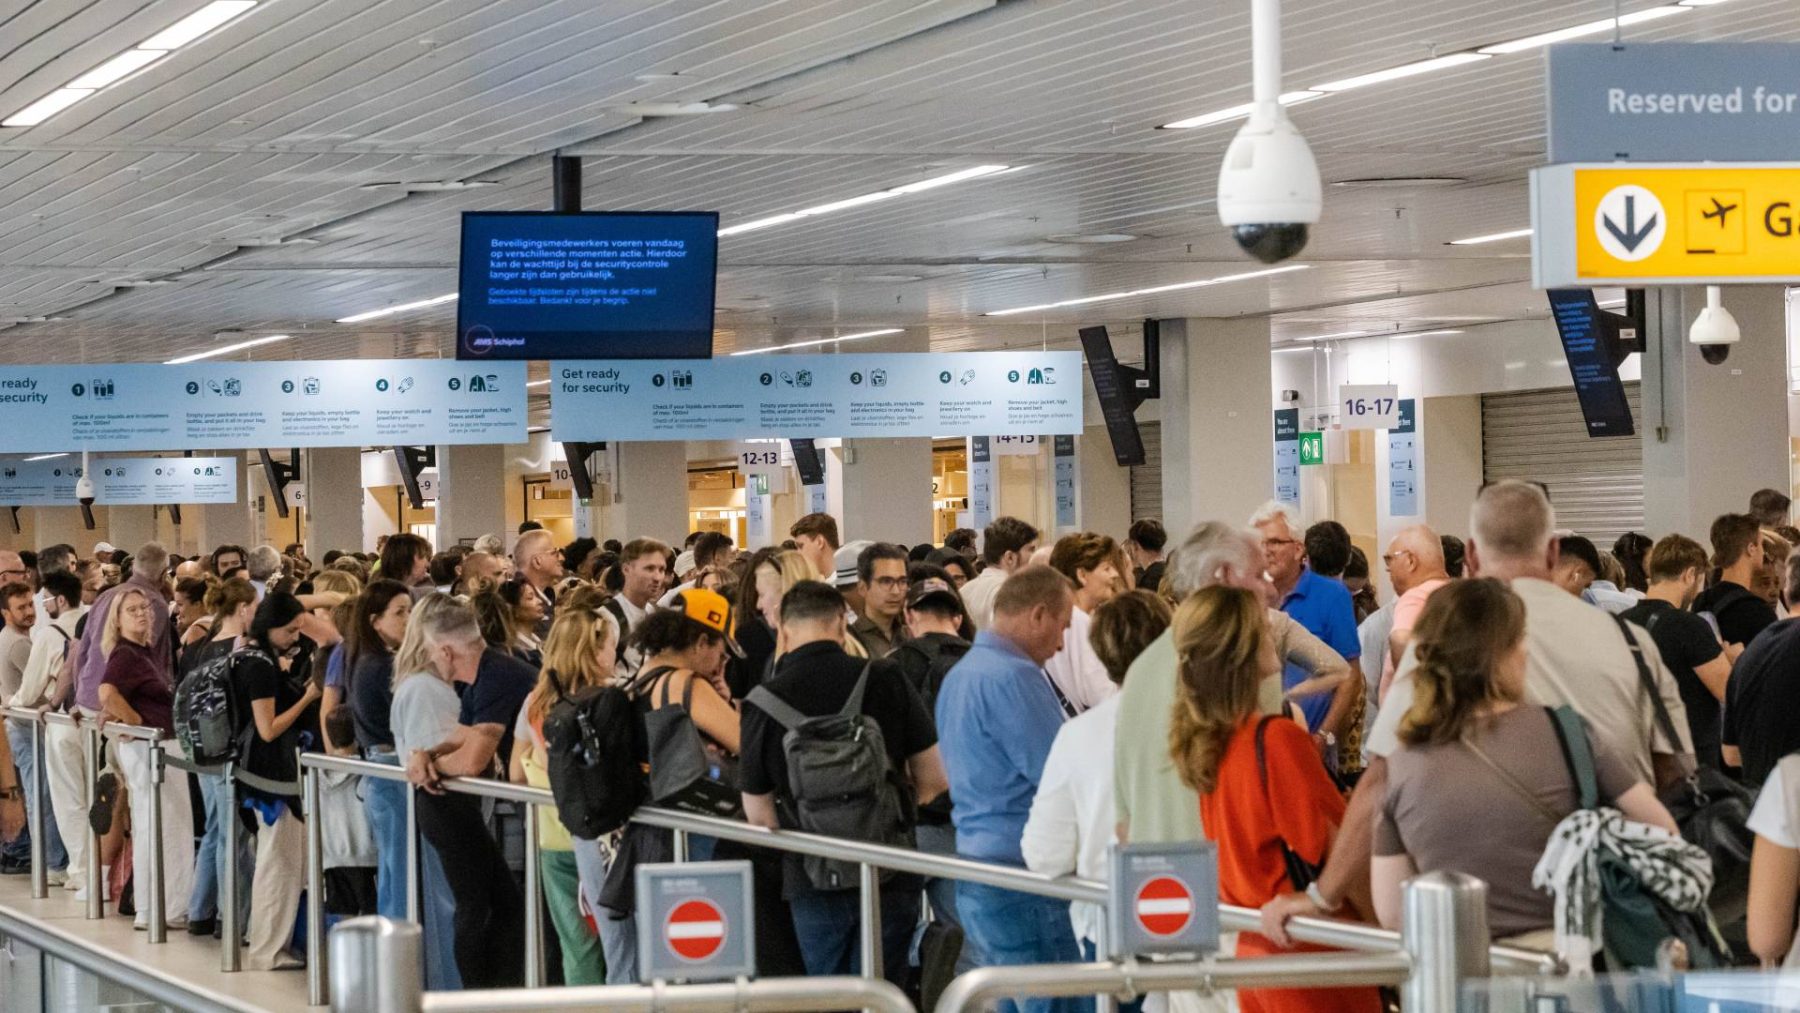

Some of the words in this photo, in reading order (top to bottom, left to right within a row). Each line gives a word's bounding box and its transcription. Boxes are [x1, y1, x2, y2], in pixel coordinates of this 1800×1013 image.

[1608, 87, 1743, 113] Reserved
[1753, 86, 1796, 113] for
[1765, 202, 1800, 237] G
[491, 239, 609, 249] Beveiligingsmedewerkers
[645, 239, 685, 248] vandaag
[490, 251, 503, 259] op
[505, 250, 567, 258] verschillende
[490, 260, 507, 268] kan
[510, 260, 521, 268] de
[524, 260, 565, 269] wachttijd
[568, 260, 578, 269] bij
[581, 260, 592, 268] de
[595, 260, 669, 269] securitycontrole
[490, 270, 519, 280] langer
[521, 270, 538, 280] zijn
[540, 270, 557, 278] dan
[559, 270, 615, 280] gebruikelijk.
[494, 338, 525, 346] Schiphol
[562, 369, 583, 379] Get
[587, 368, 620, 380] ready
[2, 377, 38, 390] ready
[562, 383, 579, 393] for
[583, 383, 630, 395] security
[0, 392, 48, 404] security
[1346, 399, 1393, 416] 16-17
[742, 452, 777, 464] 12-13
